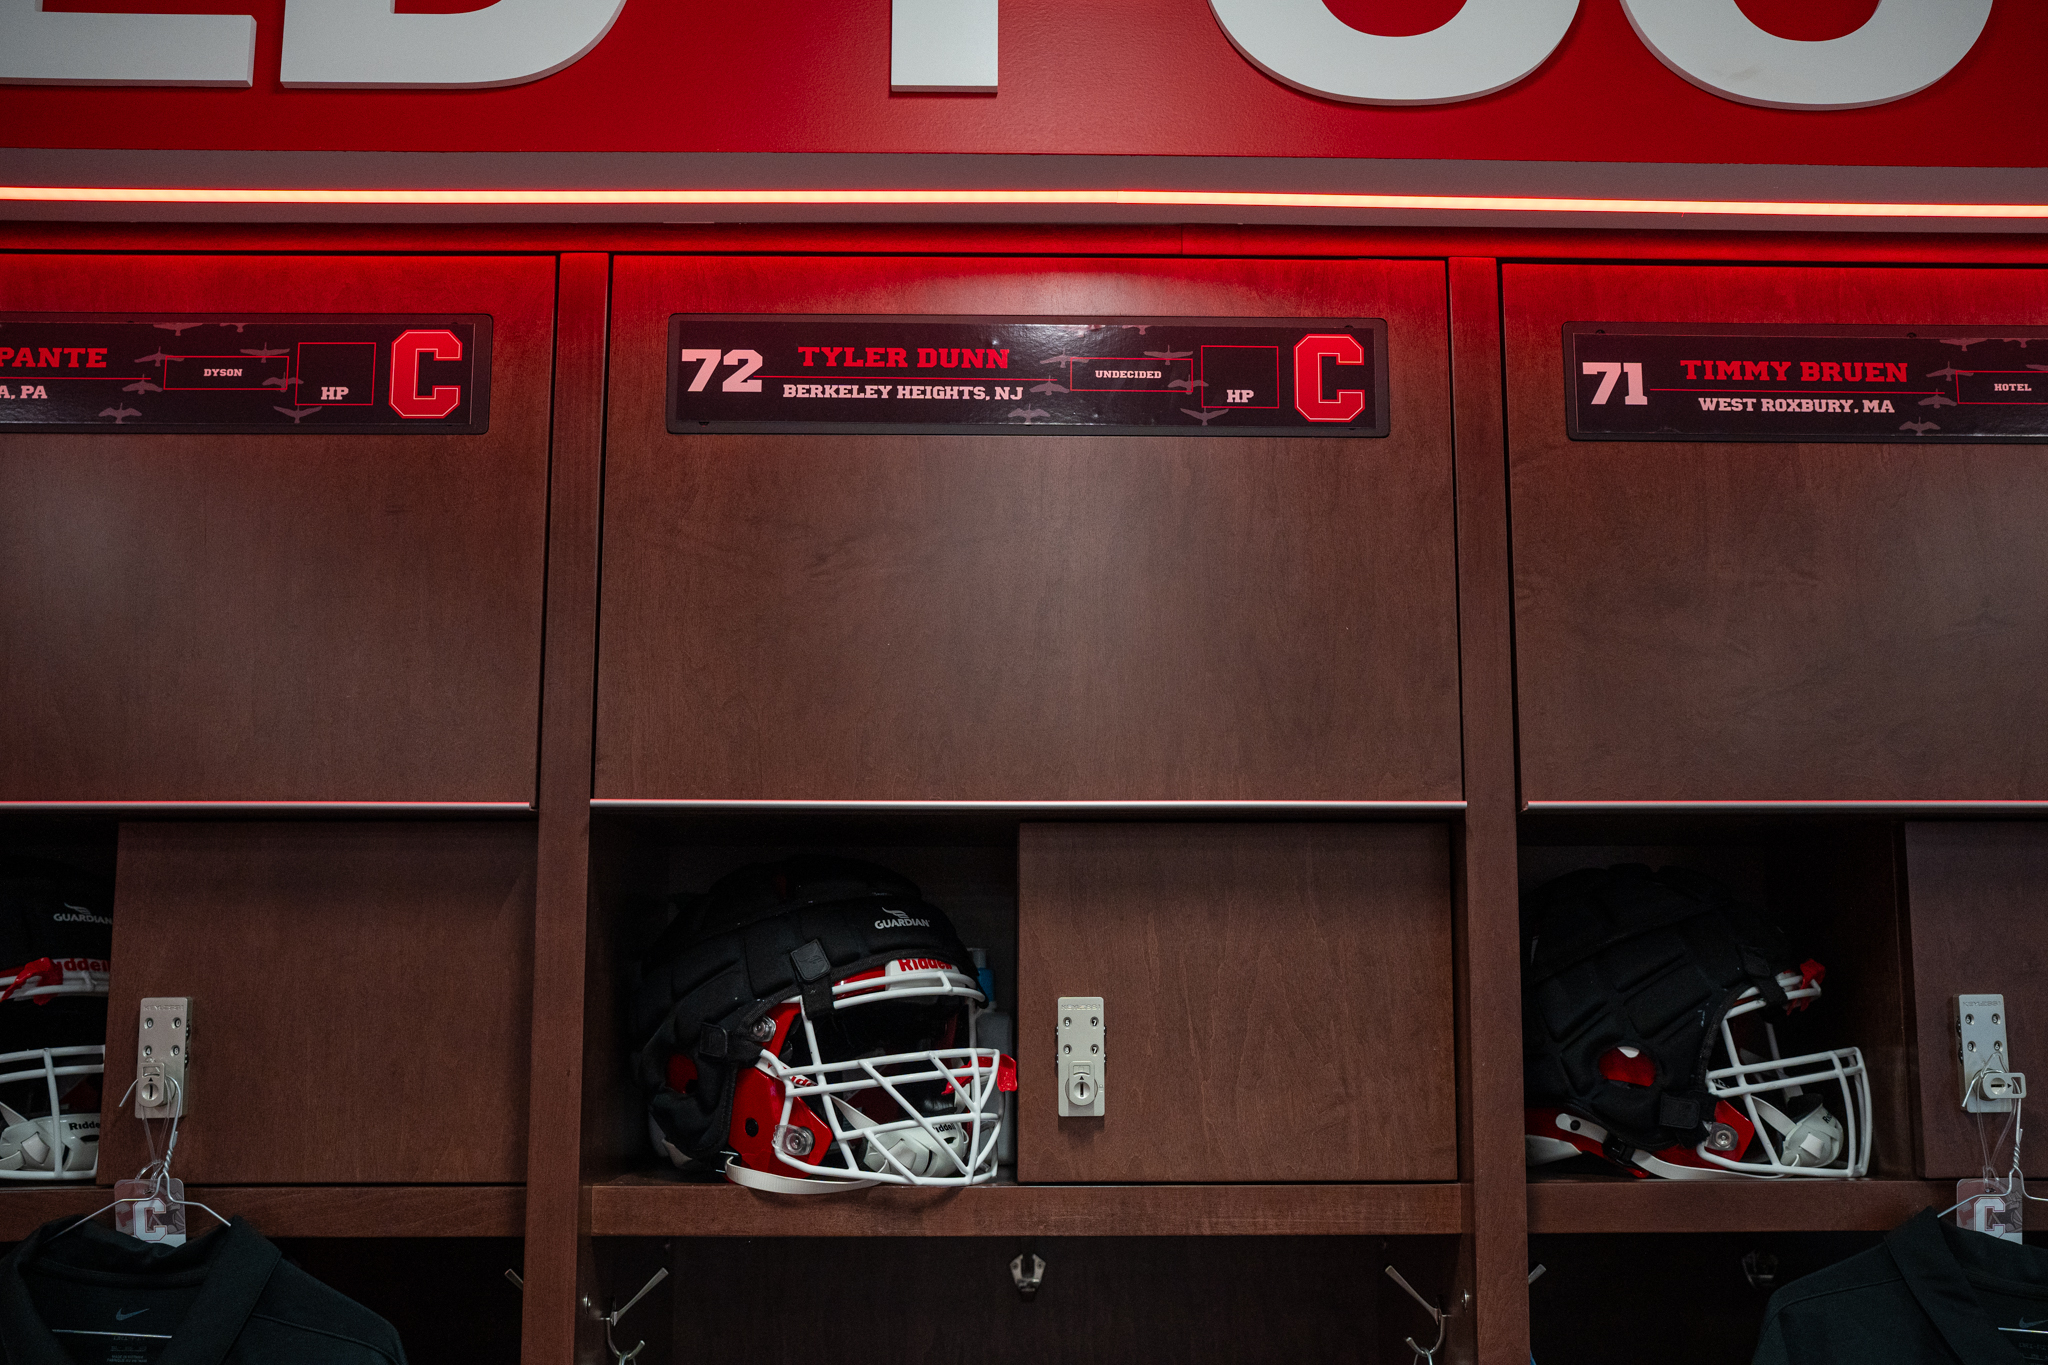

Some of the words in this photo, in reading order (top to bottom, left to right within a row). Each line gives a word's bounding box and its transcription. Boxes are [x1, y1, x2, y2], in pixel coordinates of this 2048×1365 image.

[0, 347, 108, 368] PANTE
[797, 346, 909, 368] TYLER
[917, 348, 1010, 369] DUNN
[203, 368, 243, 377] DYSON
[389, 328, 463, 419] C
[681, 348, 764, 393] 72
[1094, 370, 1163, 380] UNDECIDED
[1293, 333, 1366, 423] C
[1679, 359, 1792, 381] TIMMY
[1799, 361, 1908, 383] BRUEN
[20, 385, 48, 399] PA
[1582, 361, 1648, 406] 71
[1993, 383, 2032, 393] HOTEL
[320, 386, 349, 401] HP
[782, 384, 893, 399] BERKELEY
[896, 385, 991, 401] HEIGHTS,
[994, 386, 1024, 401] NJ
[1226, 389, 1255, 403] HP
[1697, 397, 1757, 412] WEST
[1760, 398, 1859, 414] ROXBURY,
[1862, 399, 1896, 413] MA
[53, 913, 113, 925] GUARDIAN
[874, 918, 930, 930] GUARDIAN
